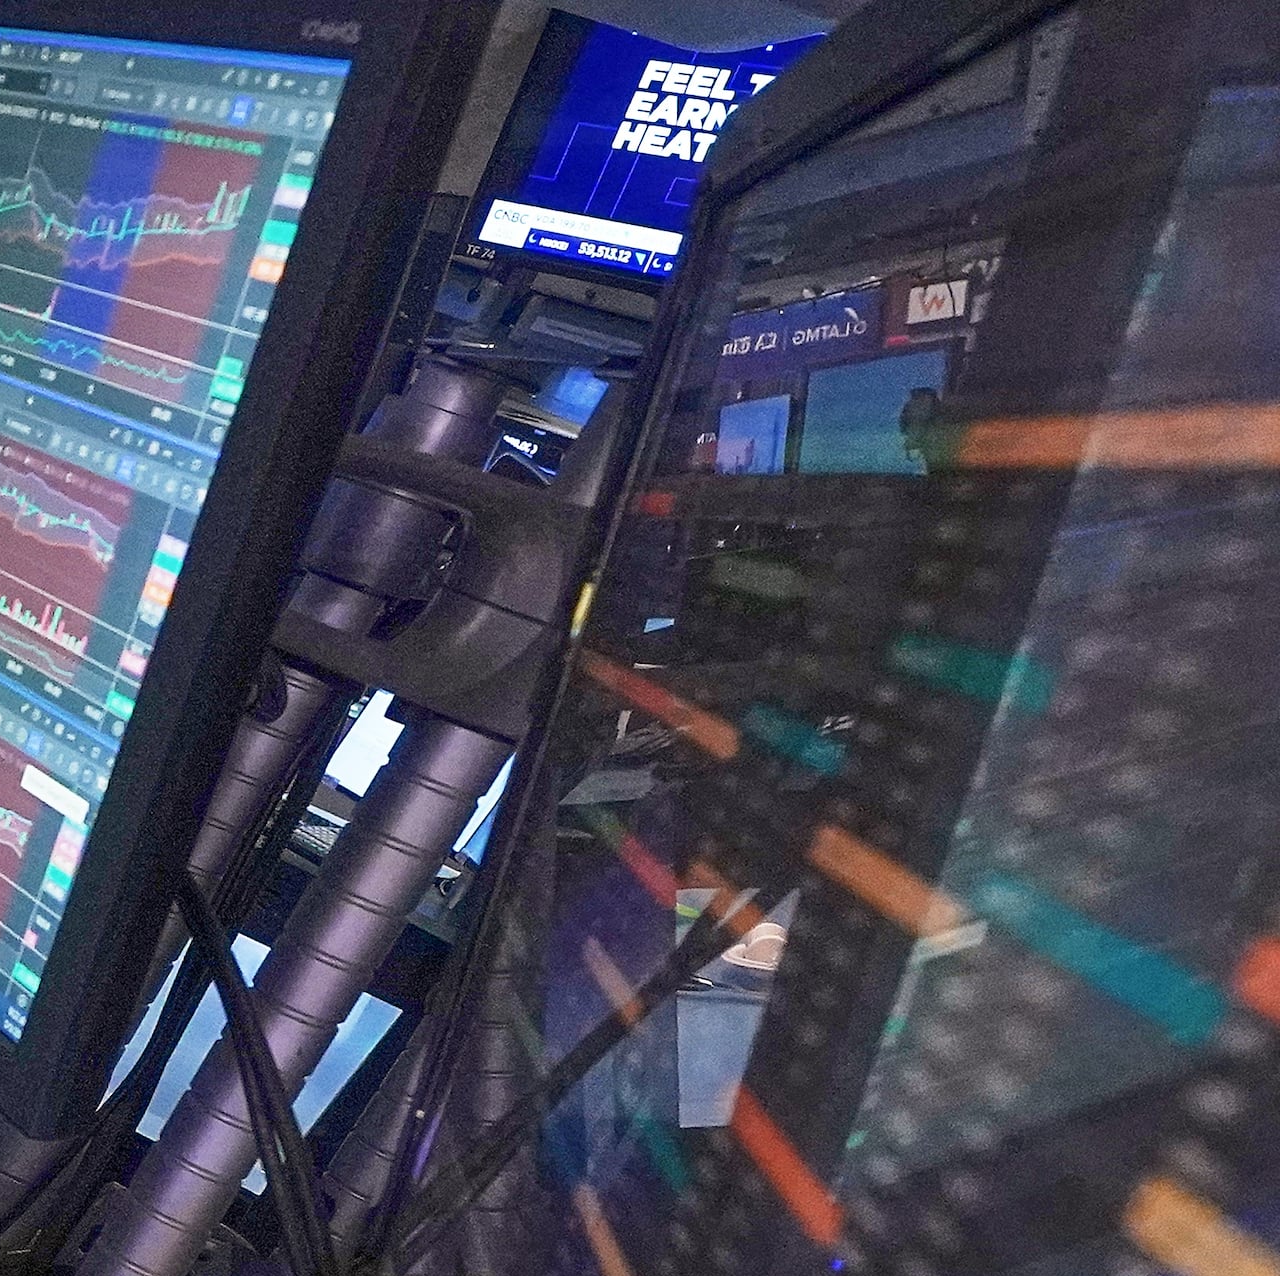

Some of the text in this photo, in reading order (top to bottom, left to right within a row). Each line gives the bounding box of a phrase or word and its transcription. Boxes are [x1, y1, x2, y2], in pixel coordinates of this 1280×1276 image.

[638, 59, 735, 101] FEEL
[611, 120, 718, 163] HEAT
[494, 208, 529, 225] CNBC
